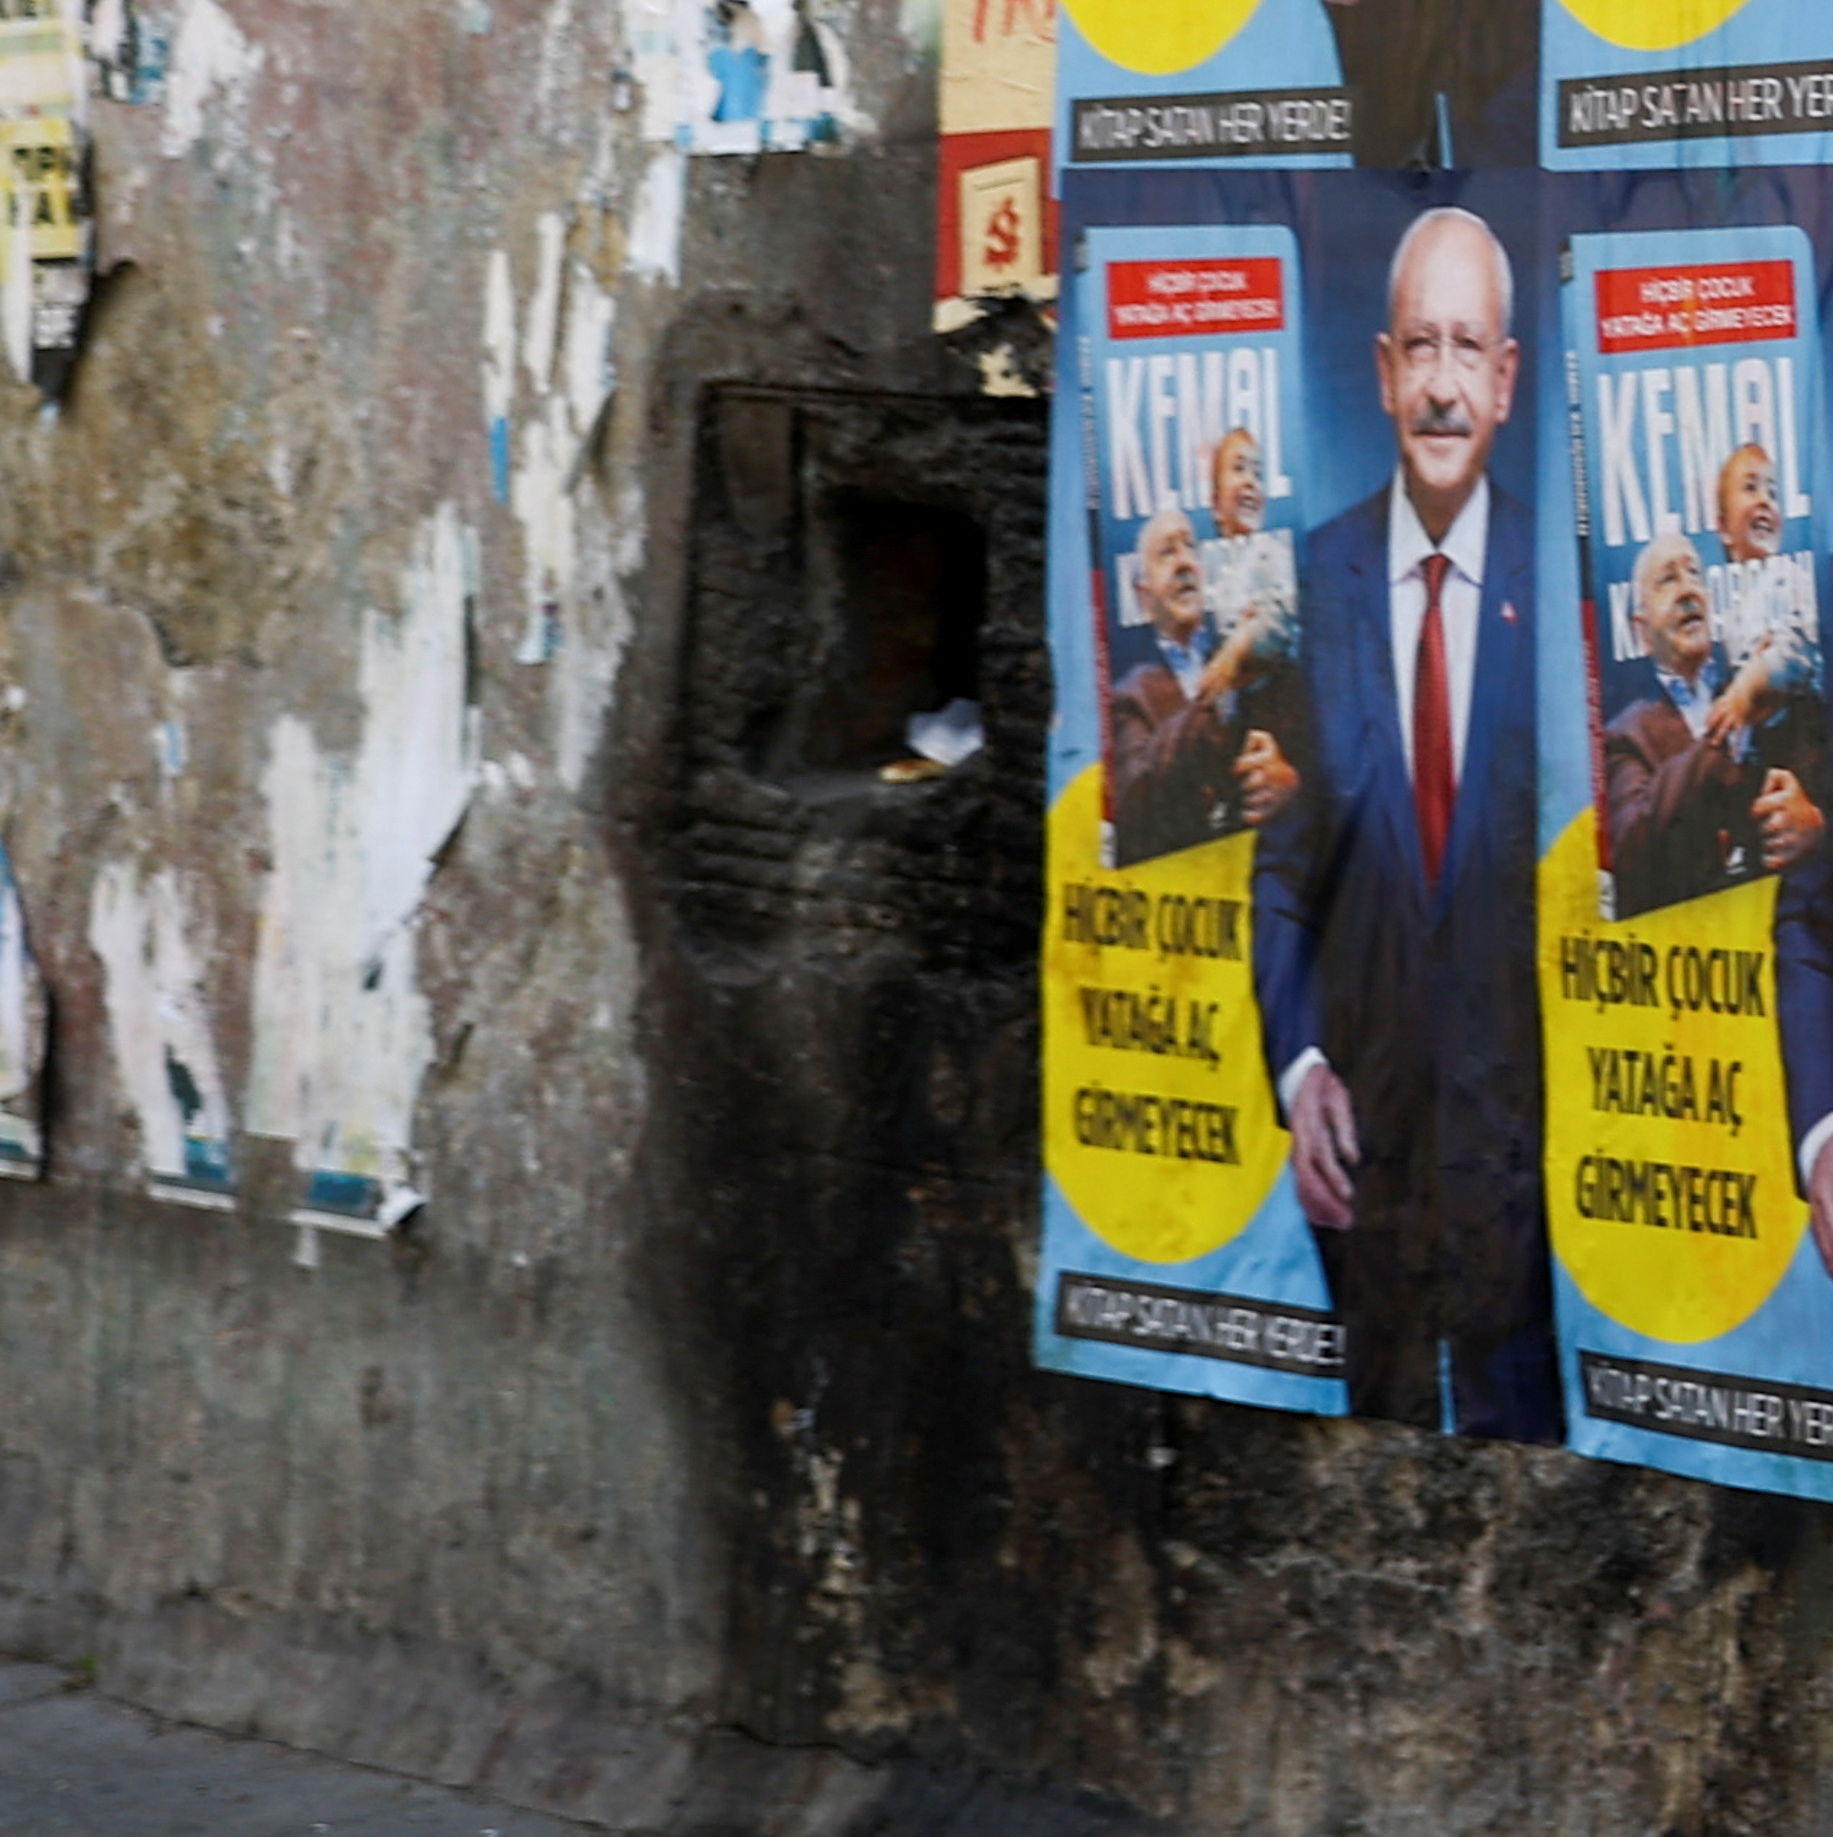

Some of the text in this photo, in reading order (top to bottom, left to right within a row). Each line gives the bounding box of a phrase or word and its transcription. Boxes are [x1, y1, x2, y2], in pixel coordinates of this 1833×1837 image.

[1558, 929, 1766, 1021] HİÇBİR ÇOCUK
[1587, 1043, 1743, 1138] YATAĞA AÇ
[1576, 1148, 1757, 1239] GİRMEYECEK
